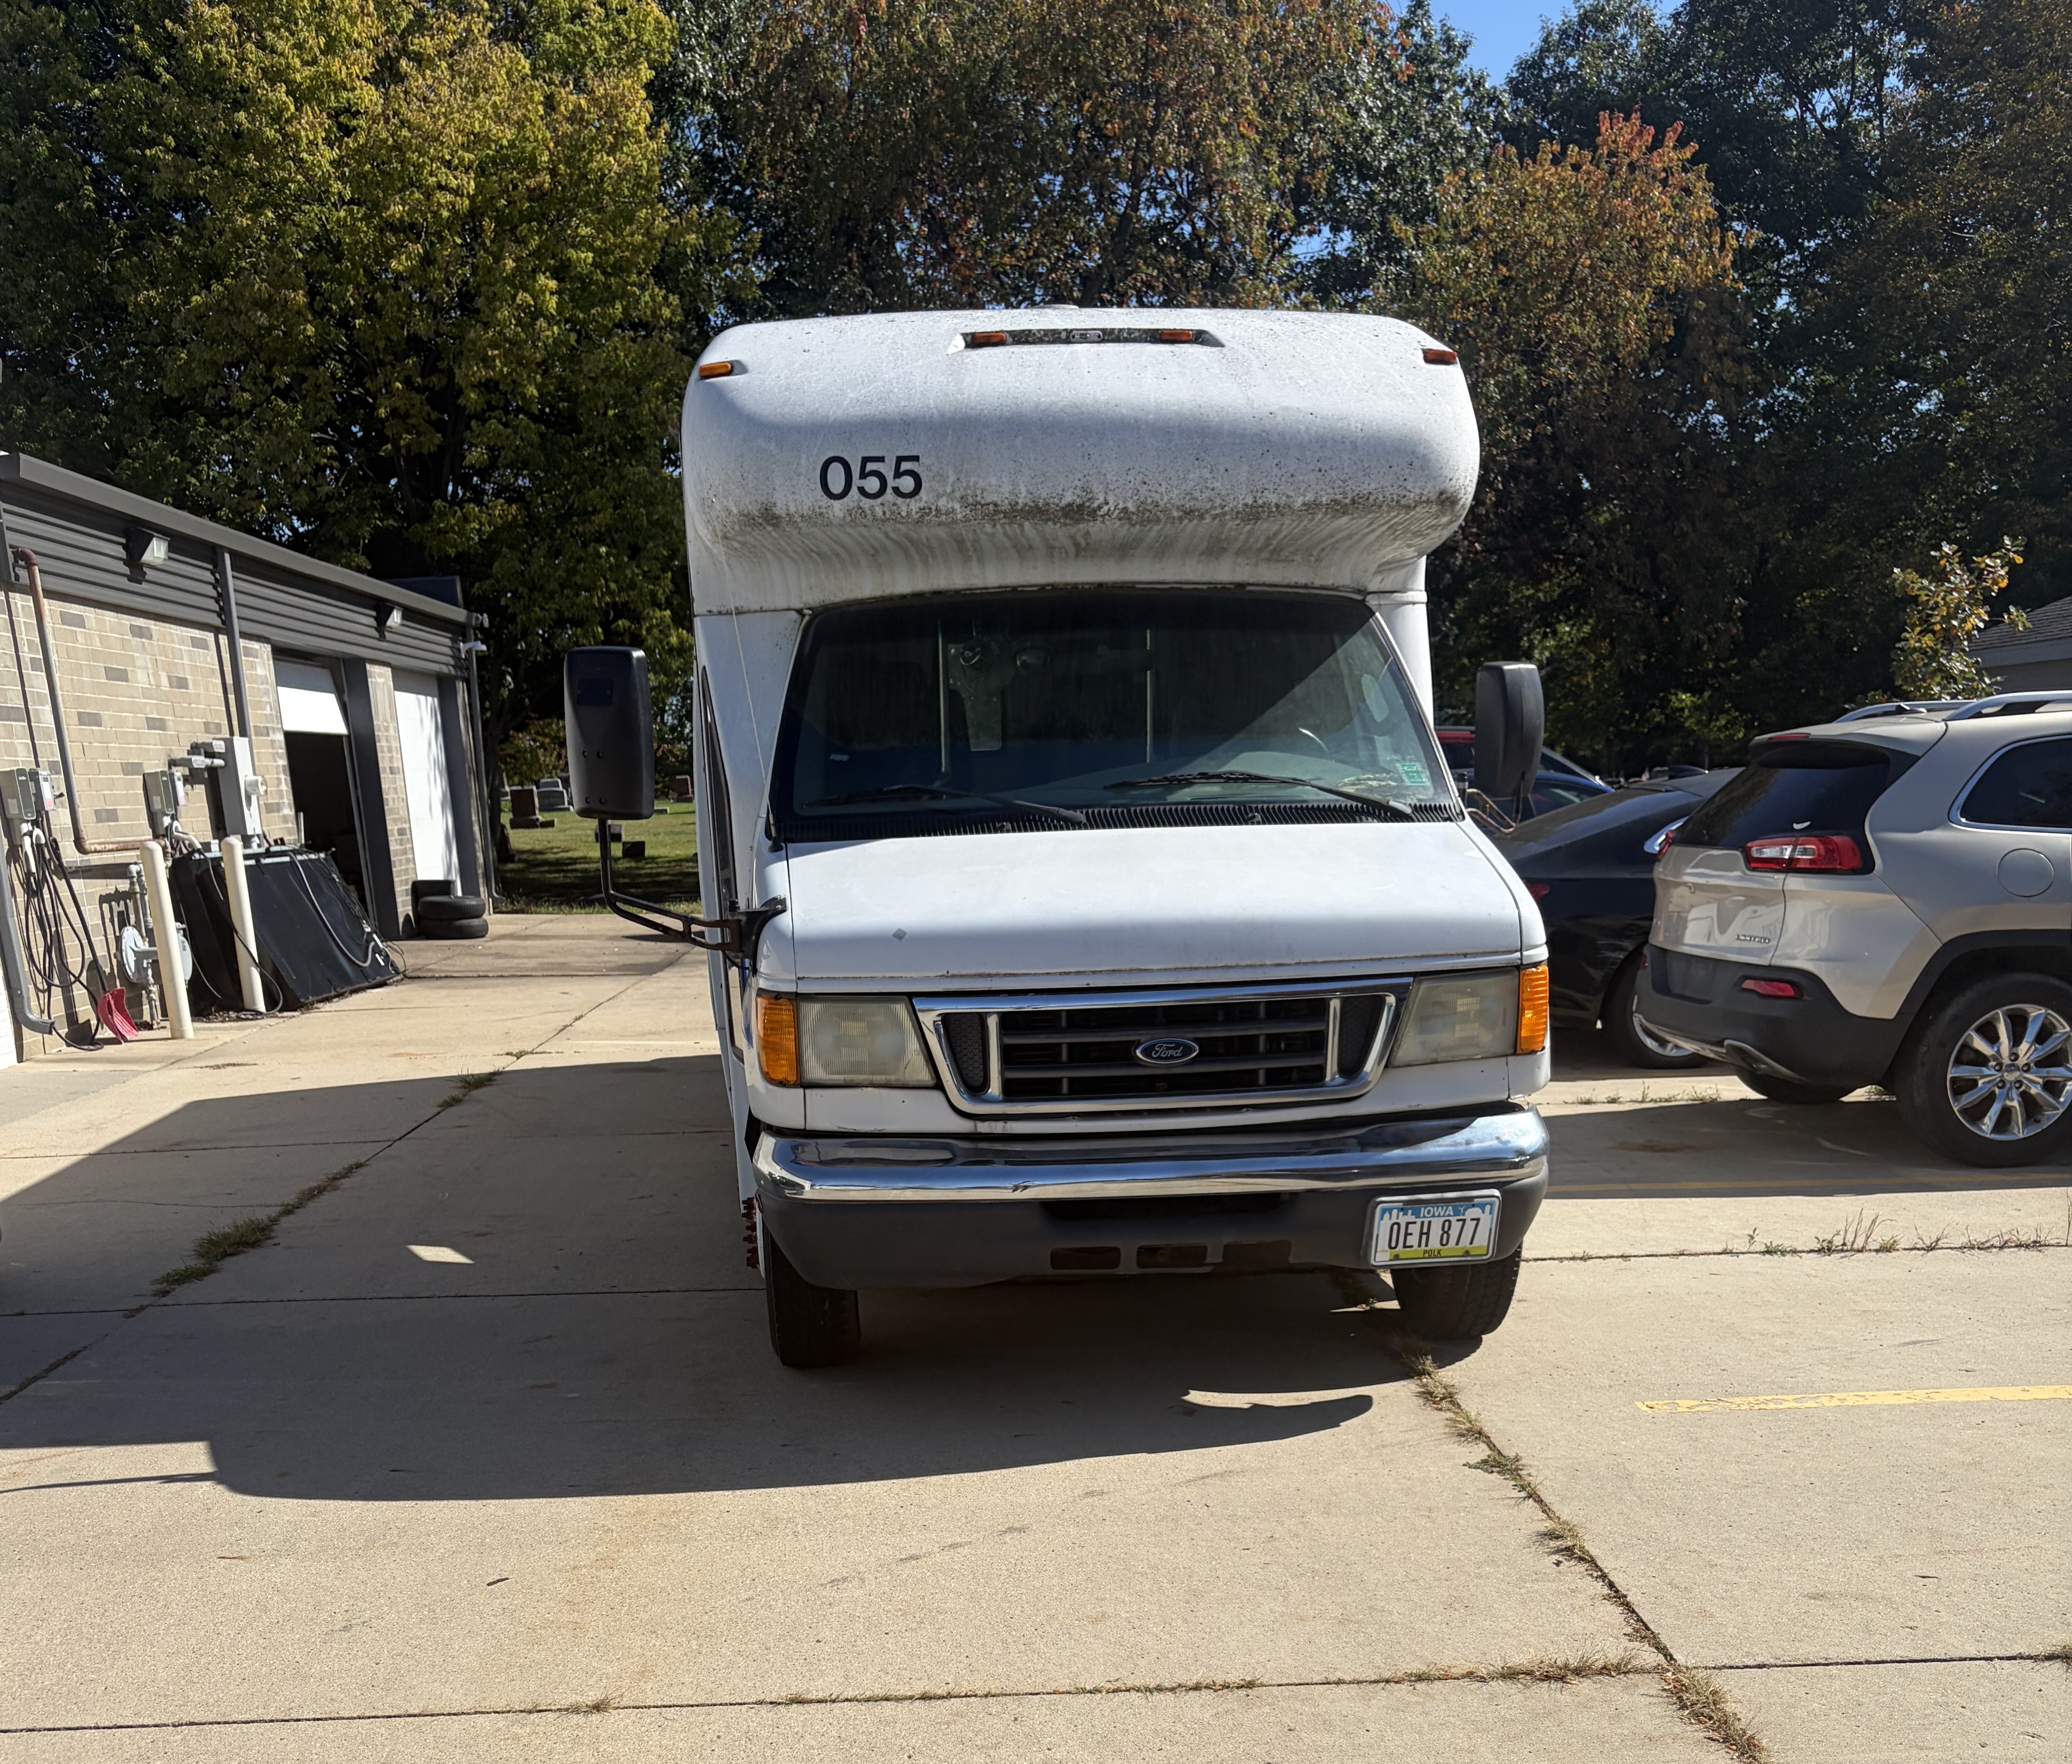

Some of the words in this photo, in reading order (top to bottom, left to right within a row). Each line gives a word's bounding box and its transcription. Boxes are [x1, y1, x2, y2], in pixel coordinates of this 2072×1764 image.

[820, 455, 922, 501] 055
[1151, 1044, 1183, 1058] Ford
[1420, 1206, 1454, 1218] IOWA
[1388, 1220, 1432, 1250] OEH
[1440, 1217, 1481, 1247] 877
[1423, 1249, 1442, 1257] POLK
